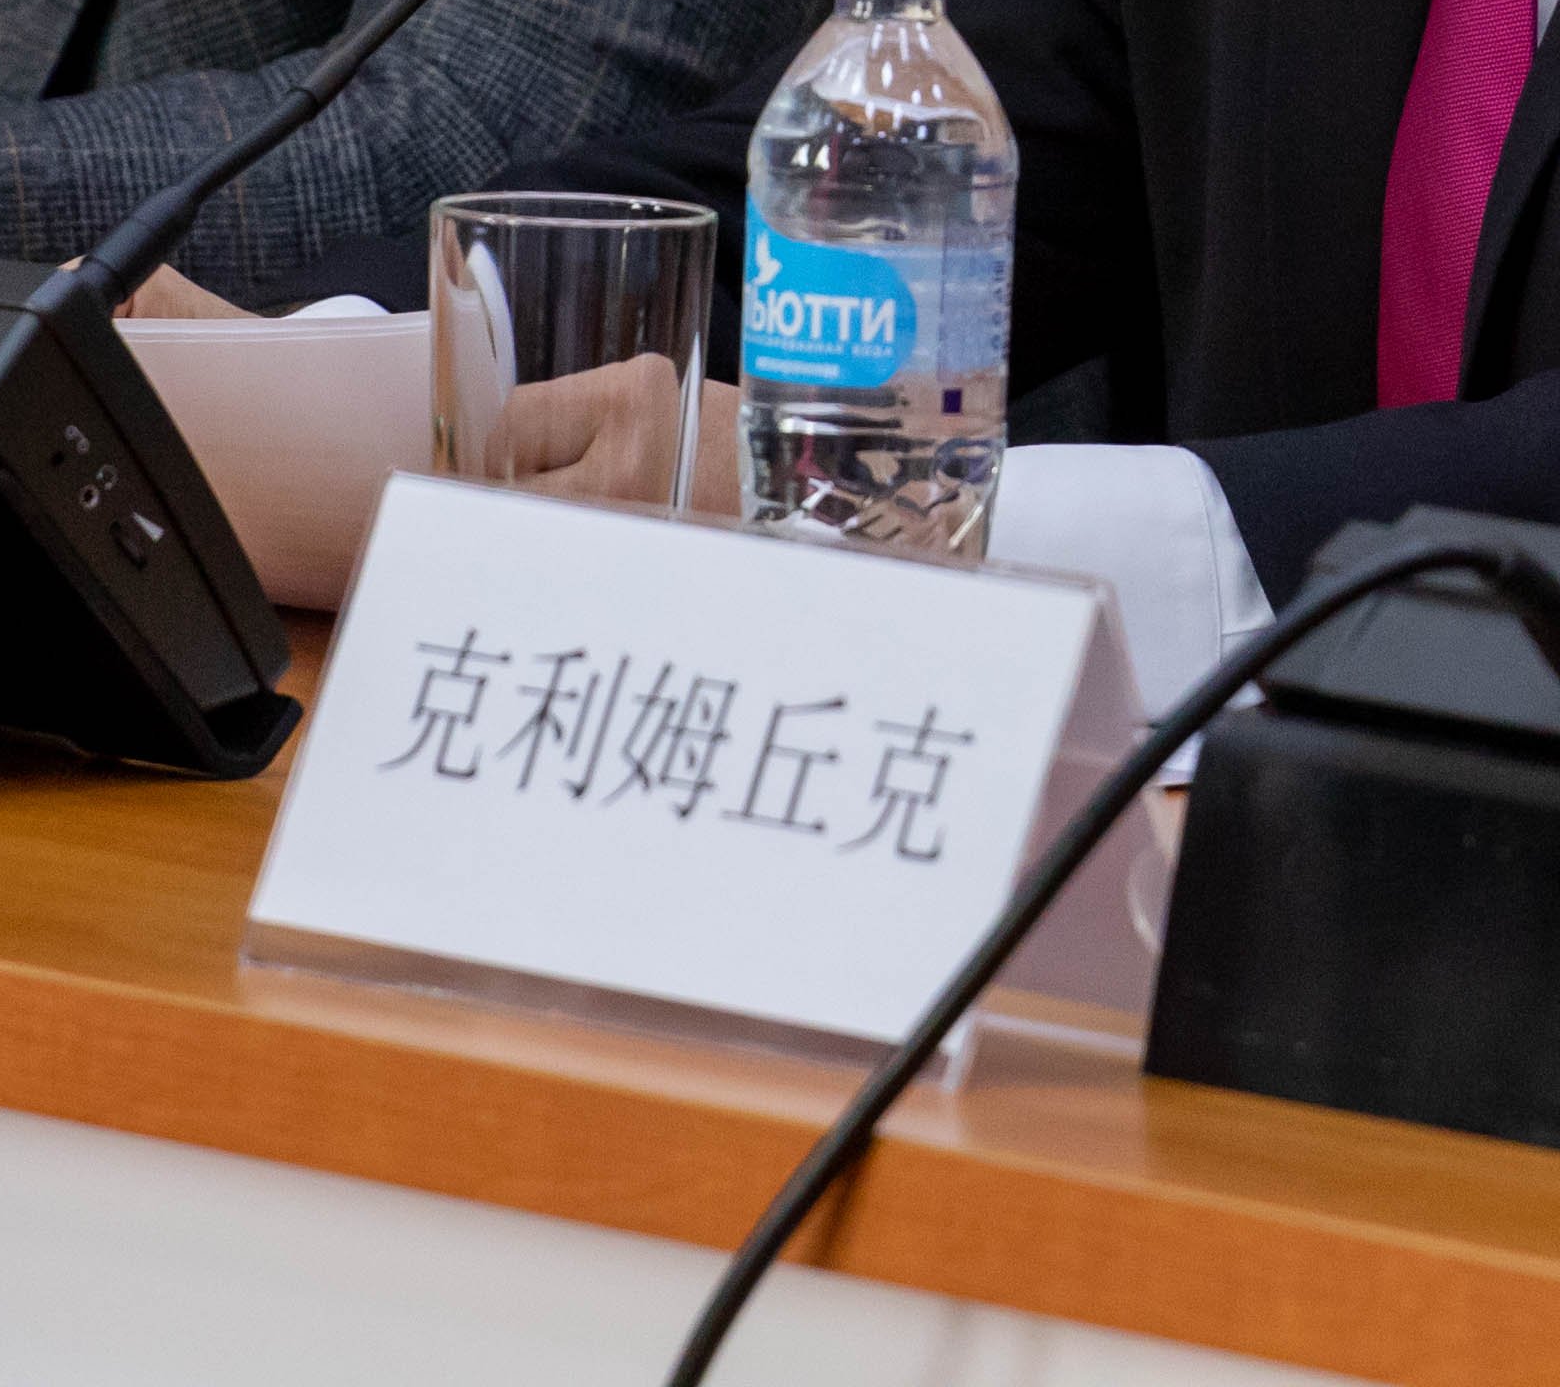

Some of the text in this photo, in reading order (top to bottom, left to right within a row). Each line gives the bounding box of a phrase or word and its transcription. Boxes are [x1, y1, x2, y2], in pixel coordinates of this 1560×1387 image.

[378, 628, 977, 864] 克利姆丘克
